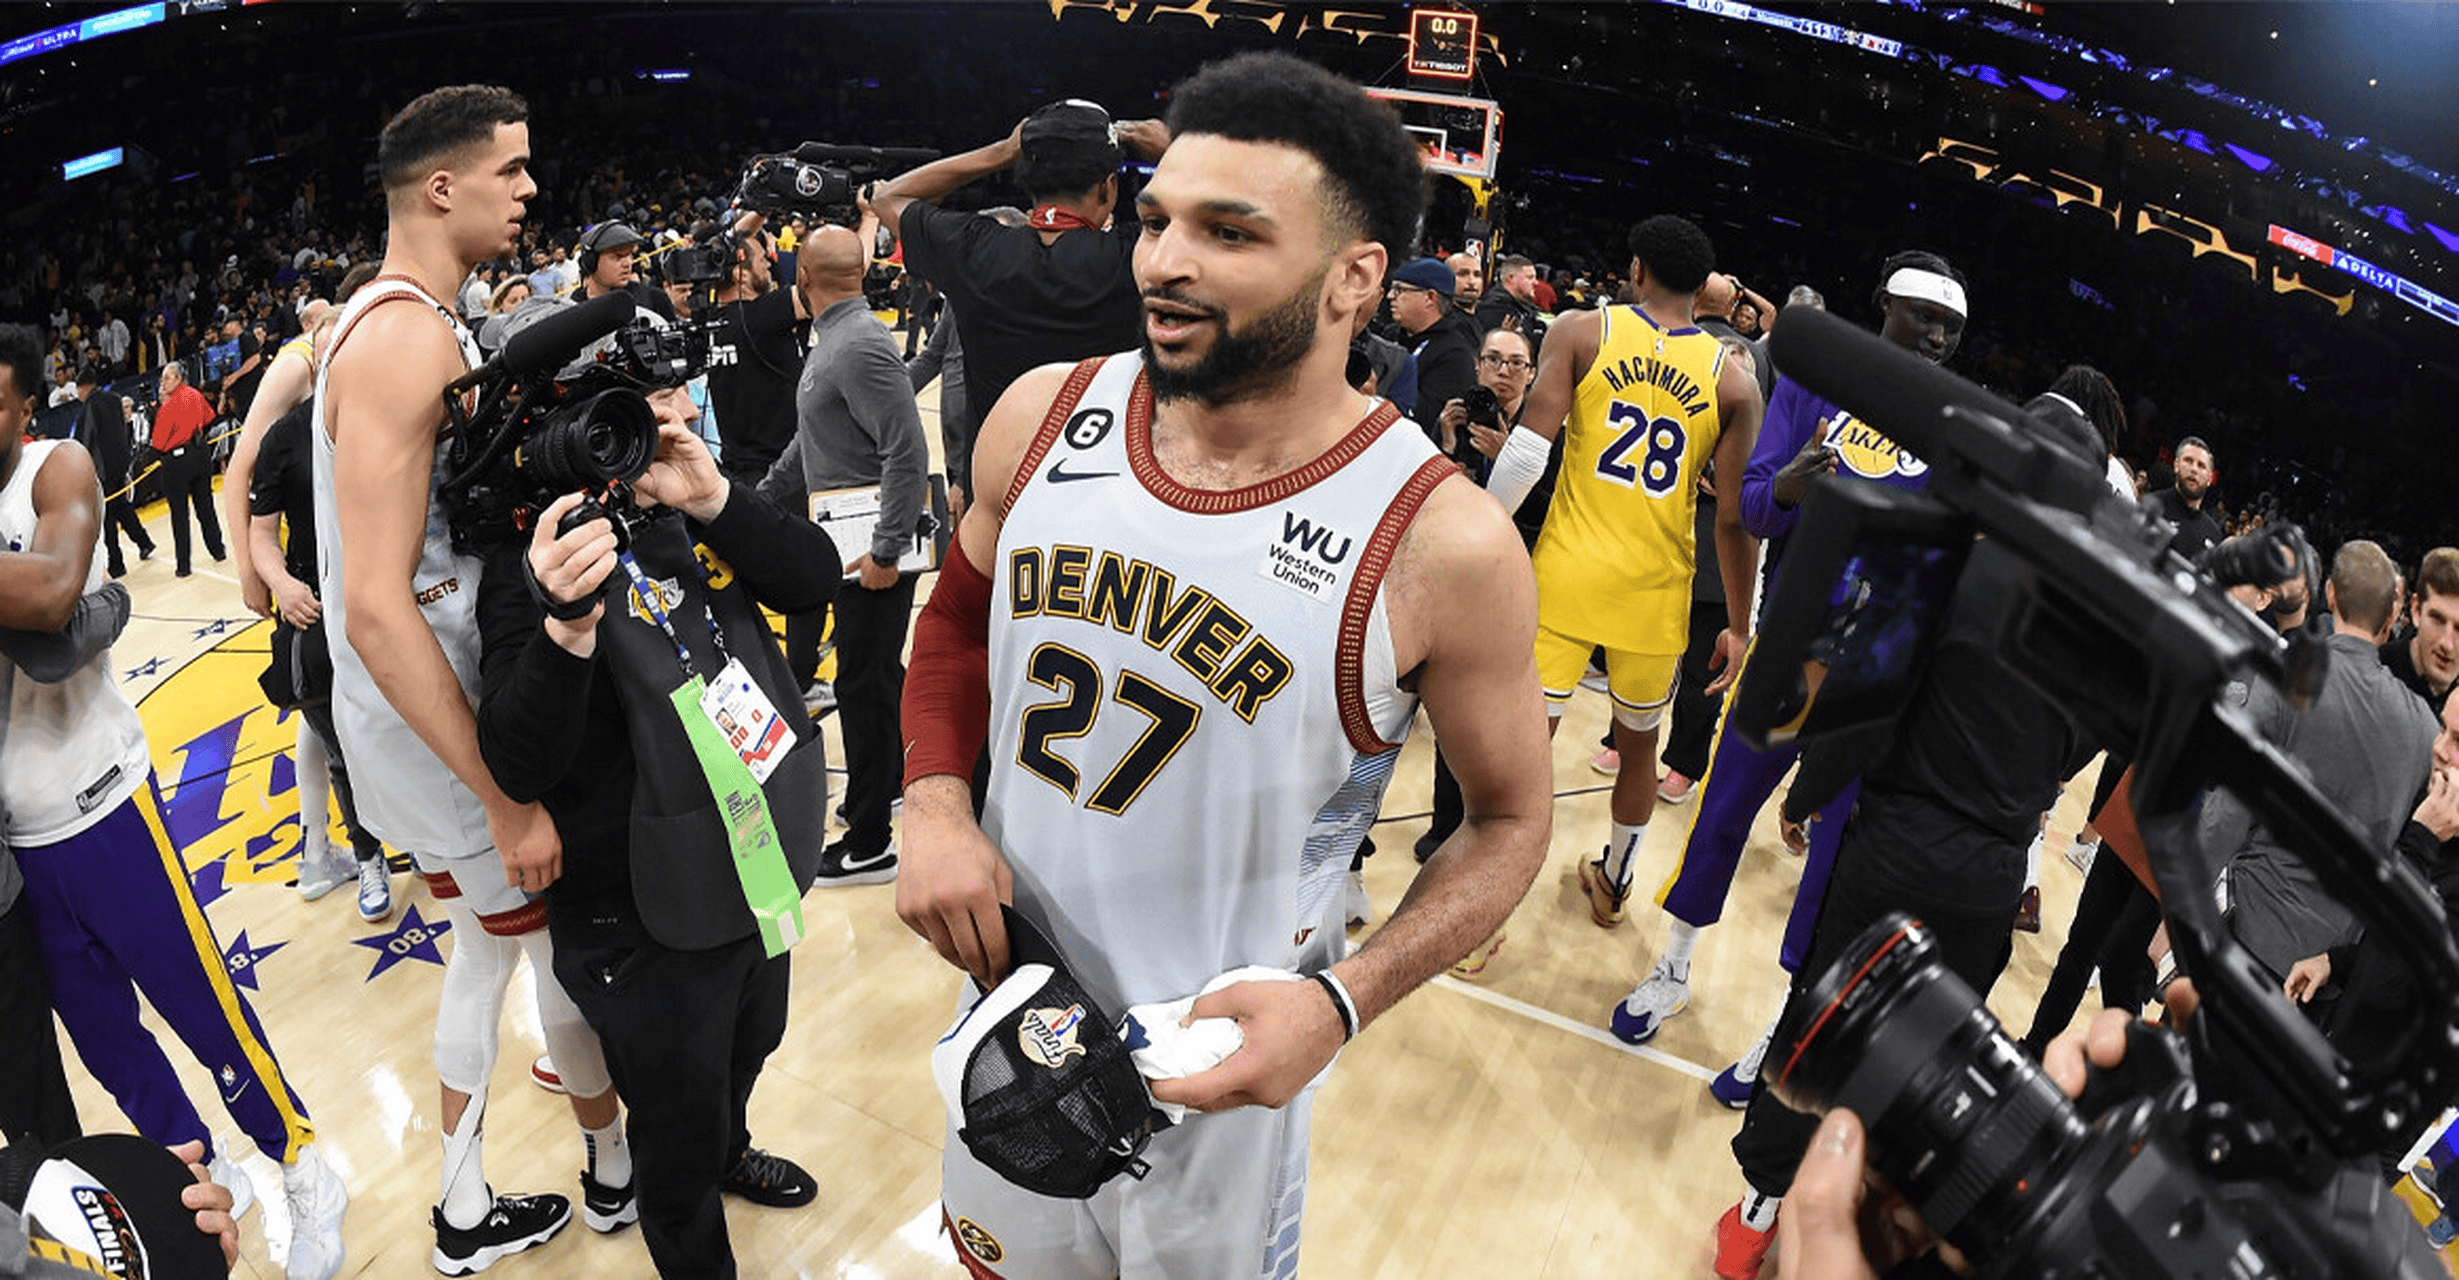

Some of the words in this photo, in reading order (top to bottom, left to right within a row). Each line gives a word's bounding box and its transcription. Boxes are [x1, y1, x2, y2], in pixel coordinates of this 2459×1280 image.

[1431, 17, 1457, 34] 0.0
[2351, 261, 2393, 288] DELTA
[1073, 413, 1108, 445] 6
[1596, 399, 1686, 498] 28
[1283, 511, 1352, 564] WU
[693, 542, 734, 590] 3
[1270, 543, 1336, 584] Western
[1273, 563, 1320, 594] Union
[416, 577, 459, 605] GGETS
[1010, 544, 1294, 725] DENVER
[1016, 641, 1203, 816] 27
[75, 1190, 126, 1272] FINALS
